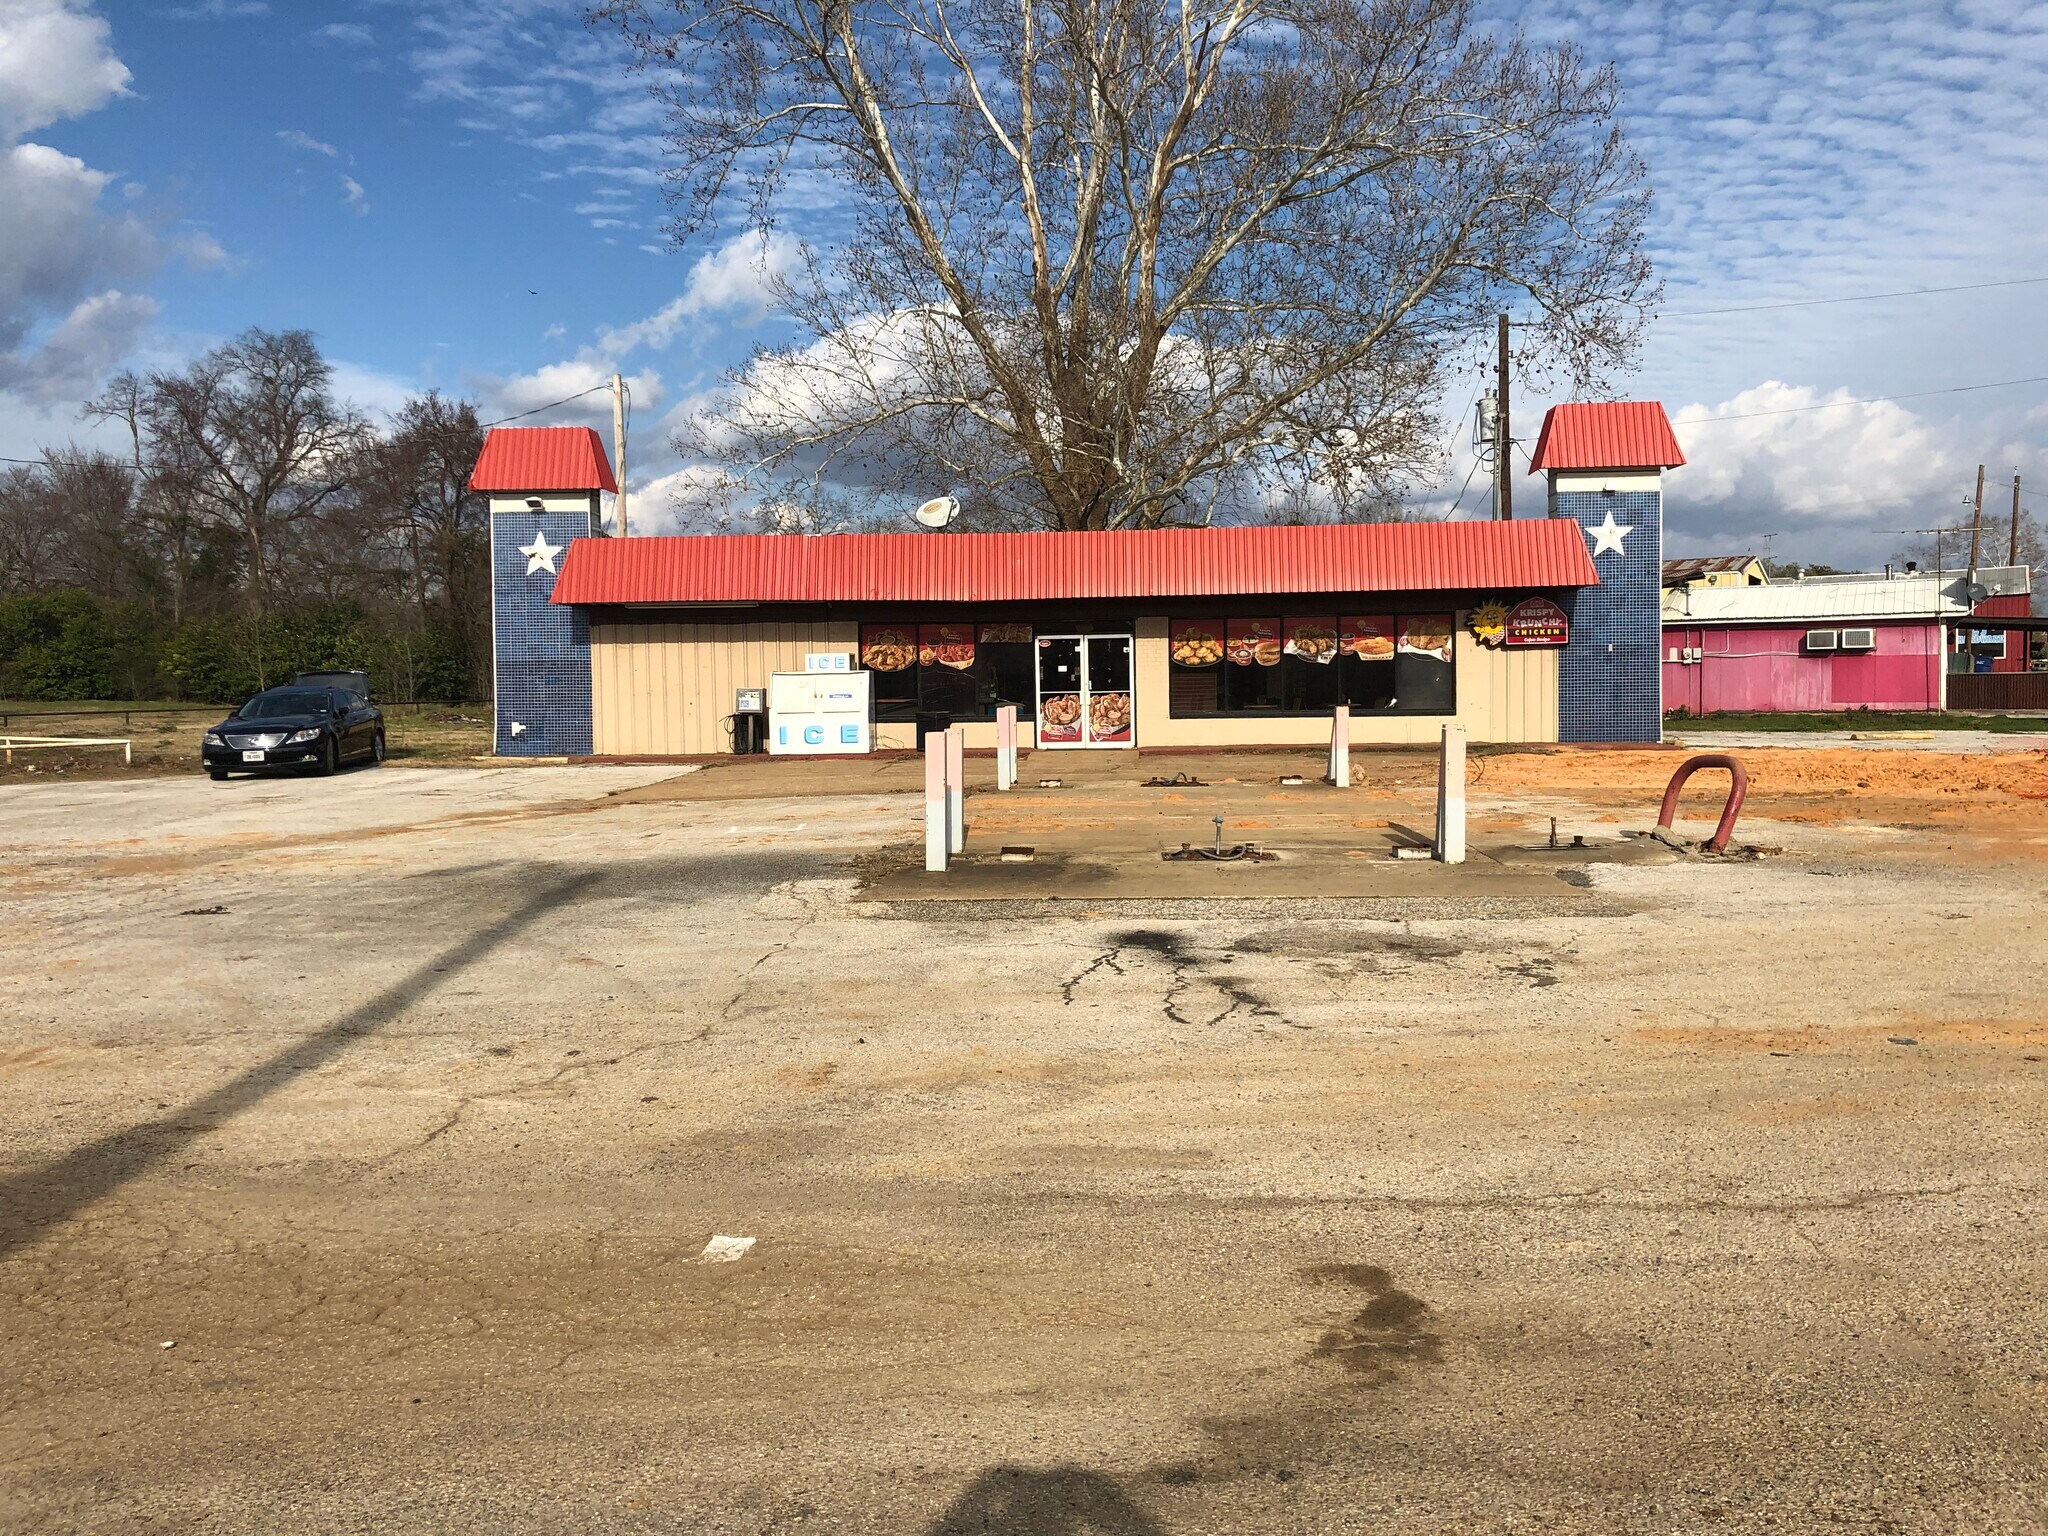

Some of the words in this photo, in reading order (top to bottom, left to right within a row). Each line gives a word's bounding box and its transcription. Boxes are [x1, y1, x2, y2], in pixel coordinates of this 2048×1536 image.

[1520, 608, 1554, 617] KRISPY
[1513, 617, 1562, 627] KRUNCHY
[1515, 628, 1560, 636] CHICKEN
[808, 655, 846, 669] ICE
[778, 724, 860, 745] ICE
